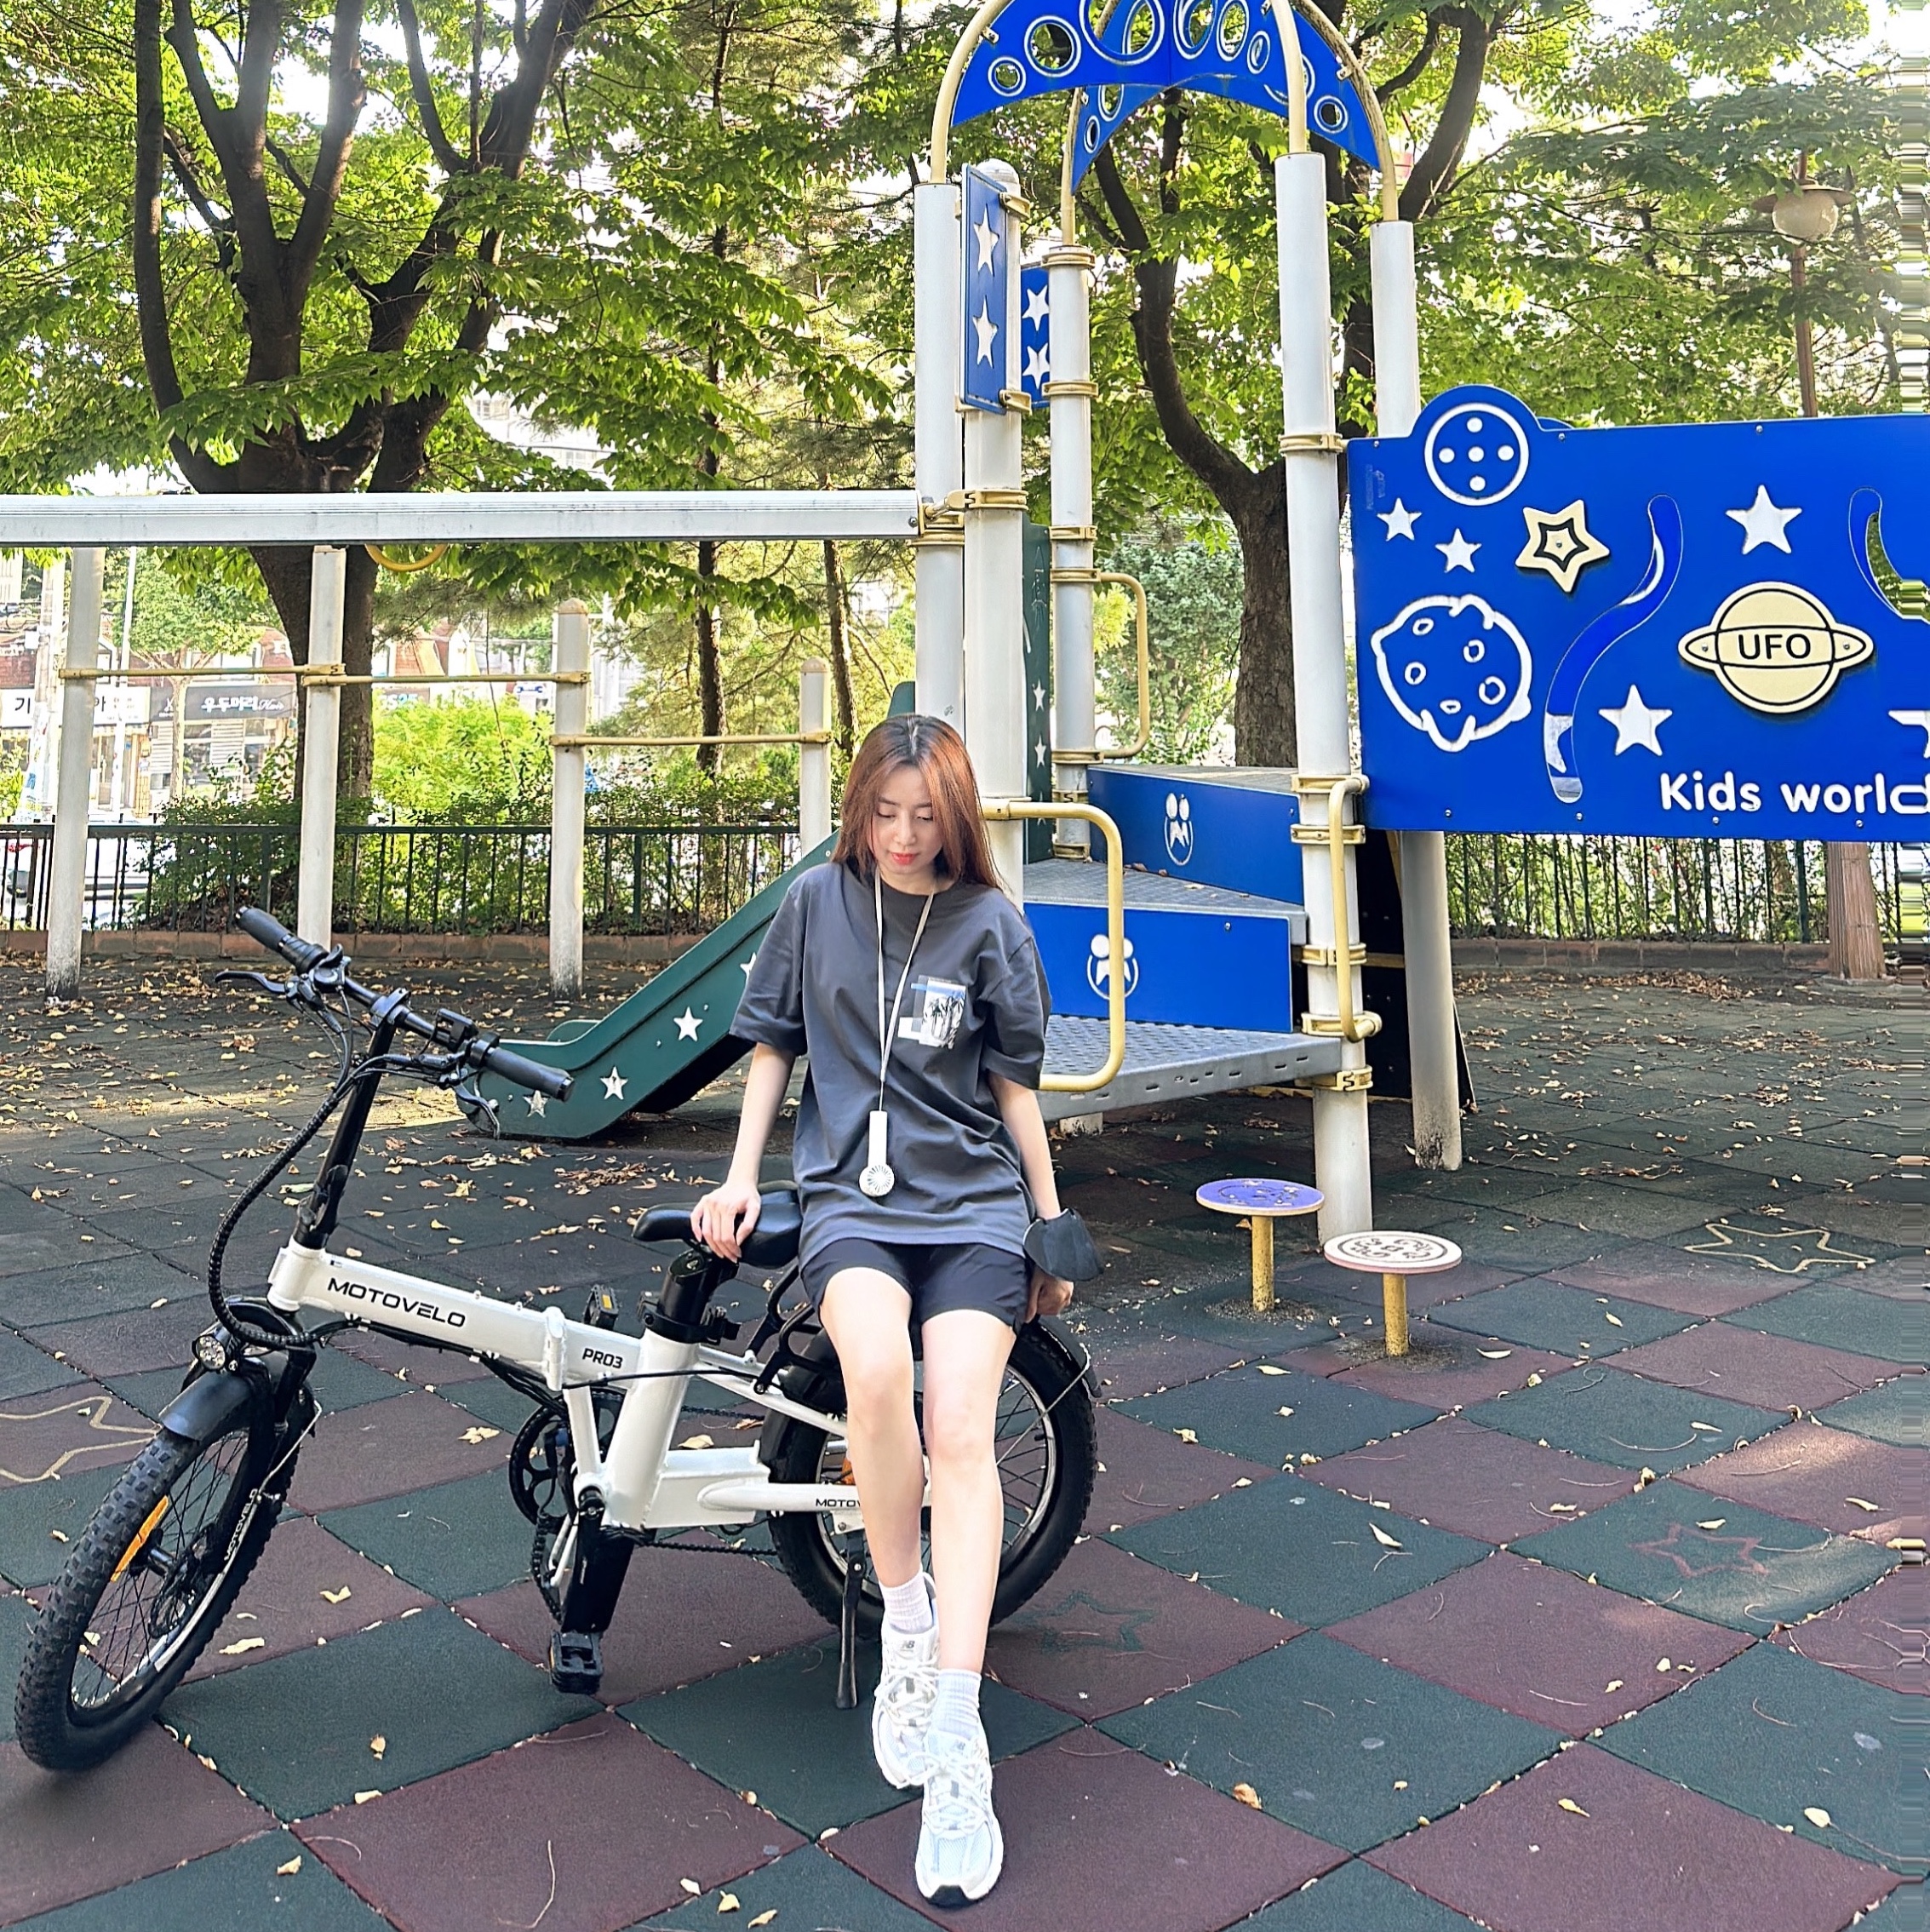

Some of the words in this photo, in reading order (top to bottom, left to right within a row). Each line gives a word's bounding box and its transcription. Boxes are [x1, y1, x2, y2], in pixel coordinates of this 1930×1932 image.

[1738, 633, 1812, 660] UFO
[1659, 770, 1762, 812] Kids
[1779, 772, 1930, 815] world
[327, 1277, 467, 1328] MOTOVELO
[581, 1347, 624, 1369] PRO3
[815, 1498, 861, 1508] MOTO
[223, 1488, 259, 1562] MOTOVELO
